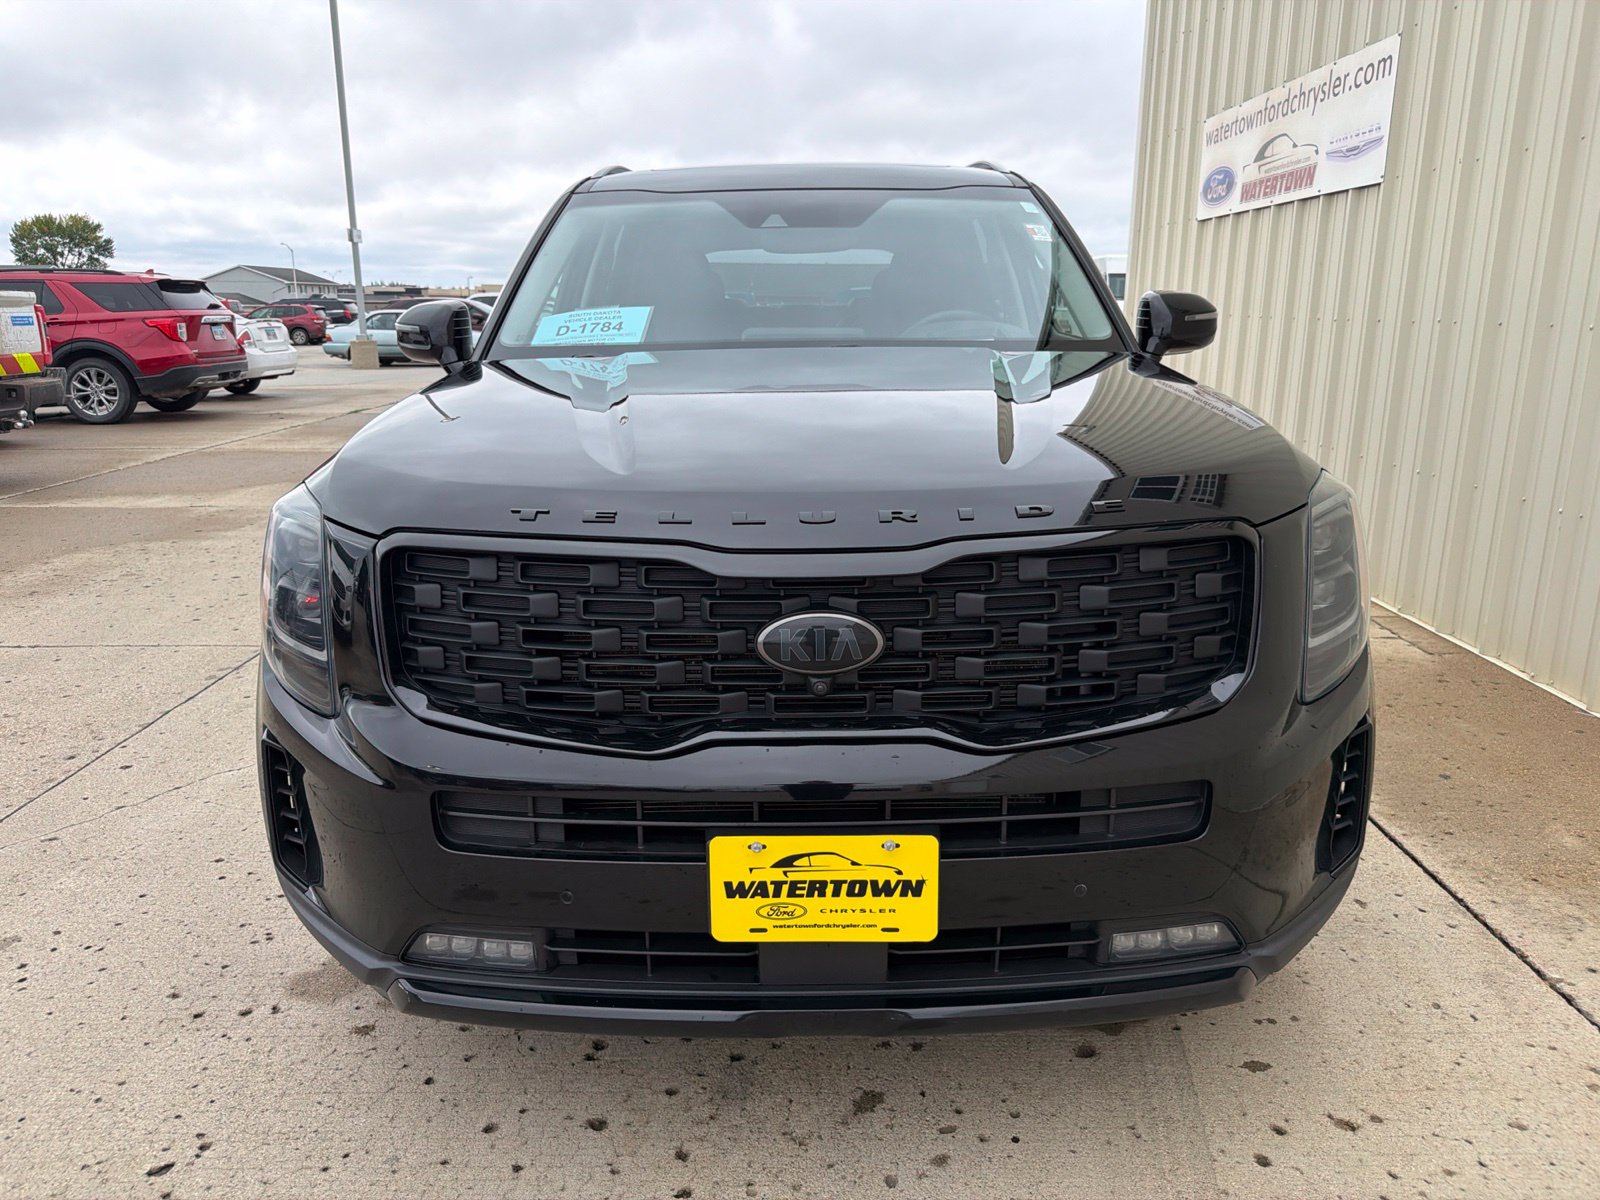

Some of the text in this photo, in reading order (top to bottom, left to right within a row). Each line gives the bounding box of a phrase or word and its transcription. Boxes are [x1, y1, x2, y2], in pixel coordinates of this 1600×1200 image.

[1205, 54, 1393, 147] watertownfordchrysler.com
[1240, 163, 1318, 204] WATERTOWN
[555, 321, 624, 337] D-1784
[510, 499, 1125, 525] TELLURIDE
[778, 627, 863, 661] KIA
[723, 879, 925, 899] WATERTOWN
[766, 904, 797, 918] Ford
